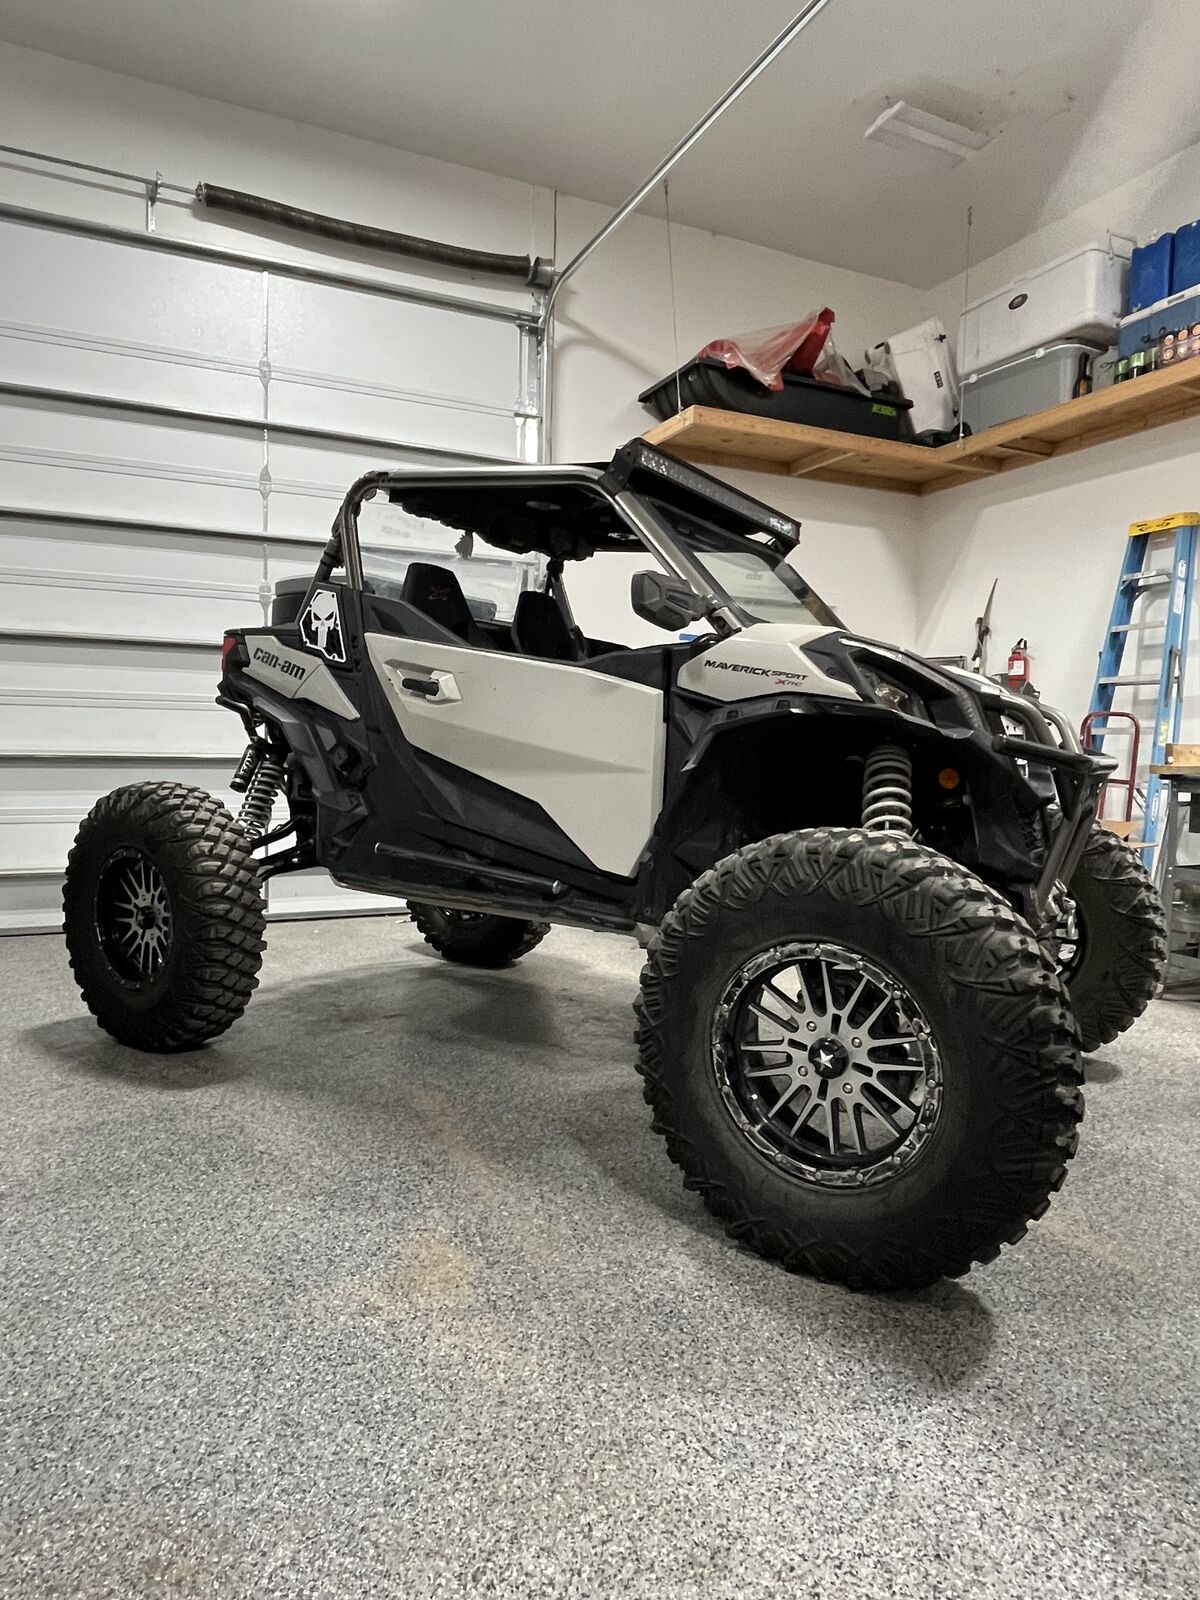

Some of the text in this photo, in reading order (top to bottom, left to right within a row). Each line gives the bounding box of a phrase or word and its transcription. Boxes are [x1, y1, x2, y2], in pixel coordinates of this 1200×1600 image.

[253, 647, 306, 680] can-am
[704, 660, 808, 680] MAVERICK SPORT
